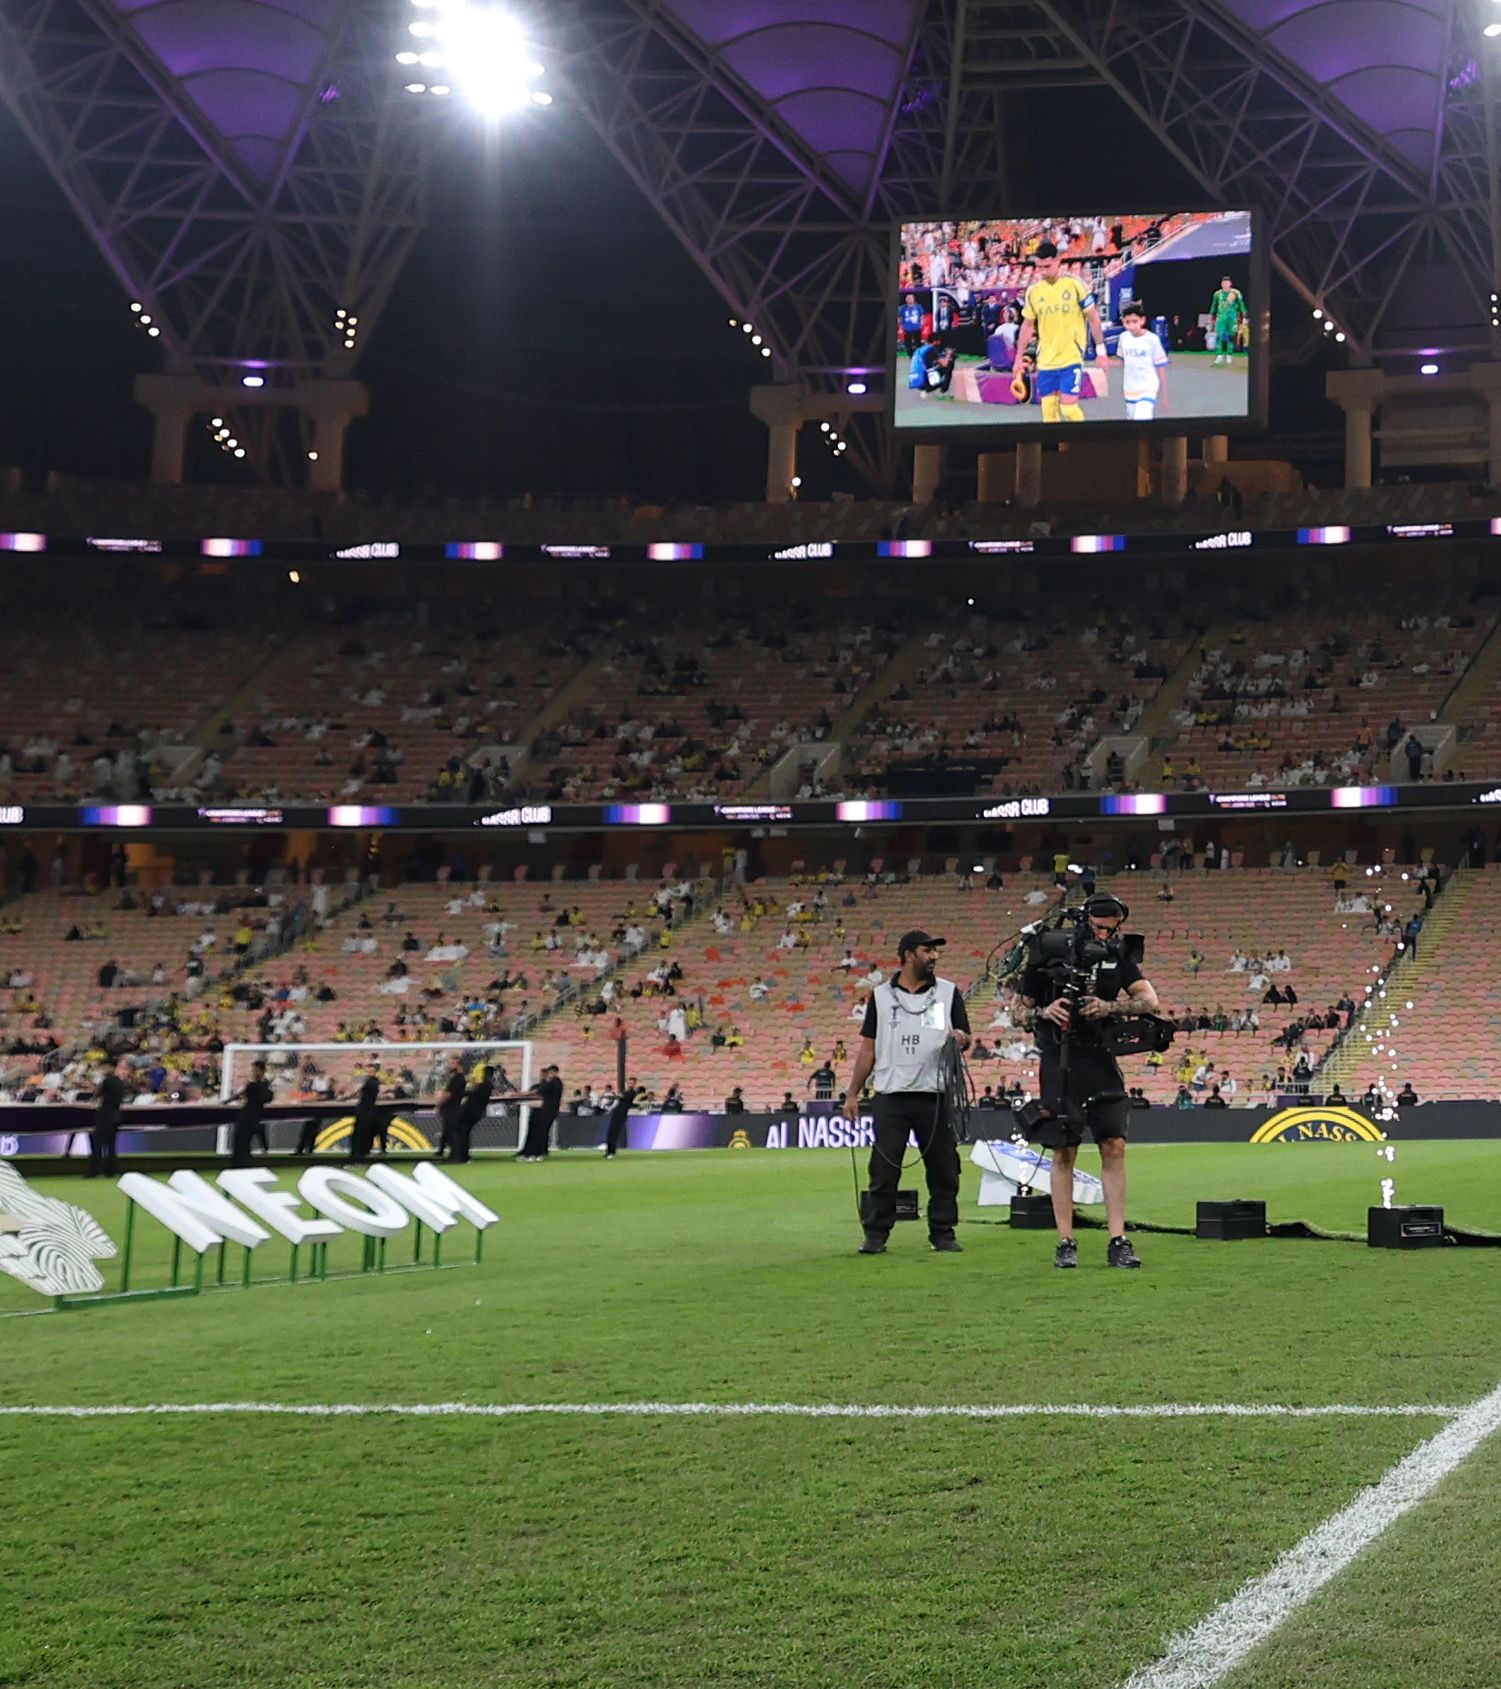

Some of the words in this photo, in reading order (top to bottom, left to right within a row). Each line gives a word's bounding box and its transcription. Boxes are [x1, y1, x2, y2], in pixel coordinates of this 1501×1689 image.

[901, 1034, 920, 1046] HB
[905, 1046, 916, 1055] 11
[117, 1161, 499, 1254] NEOM
